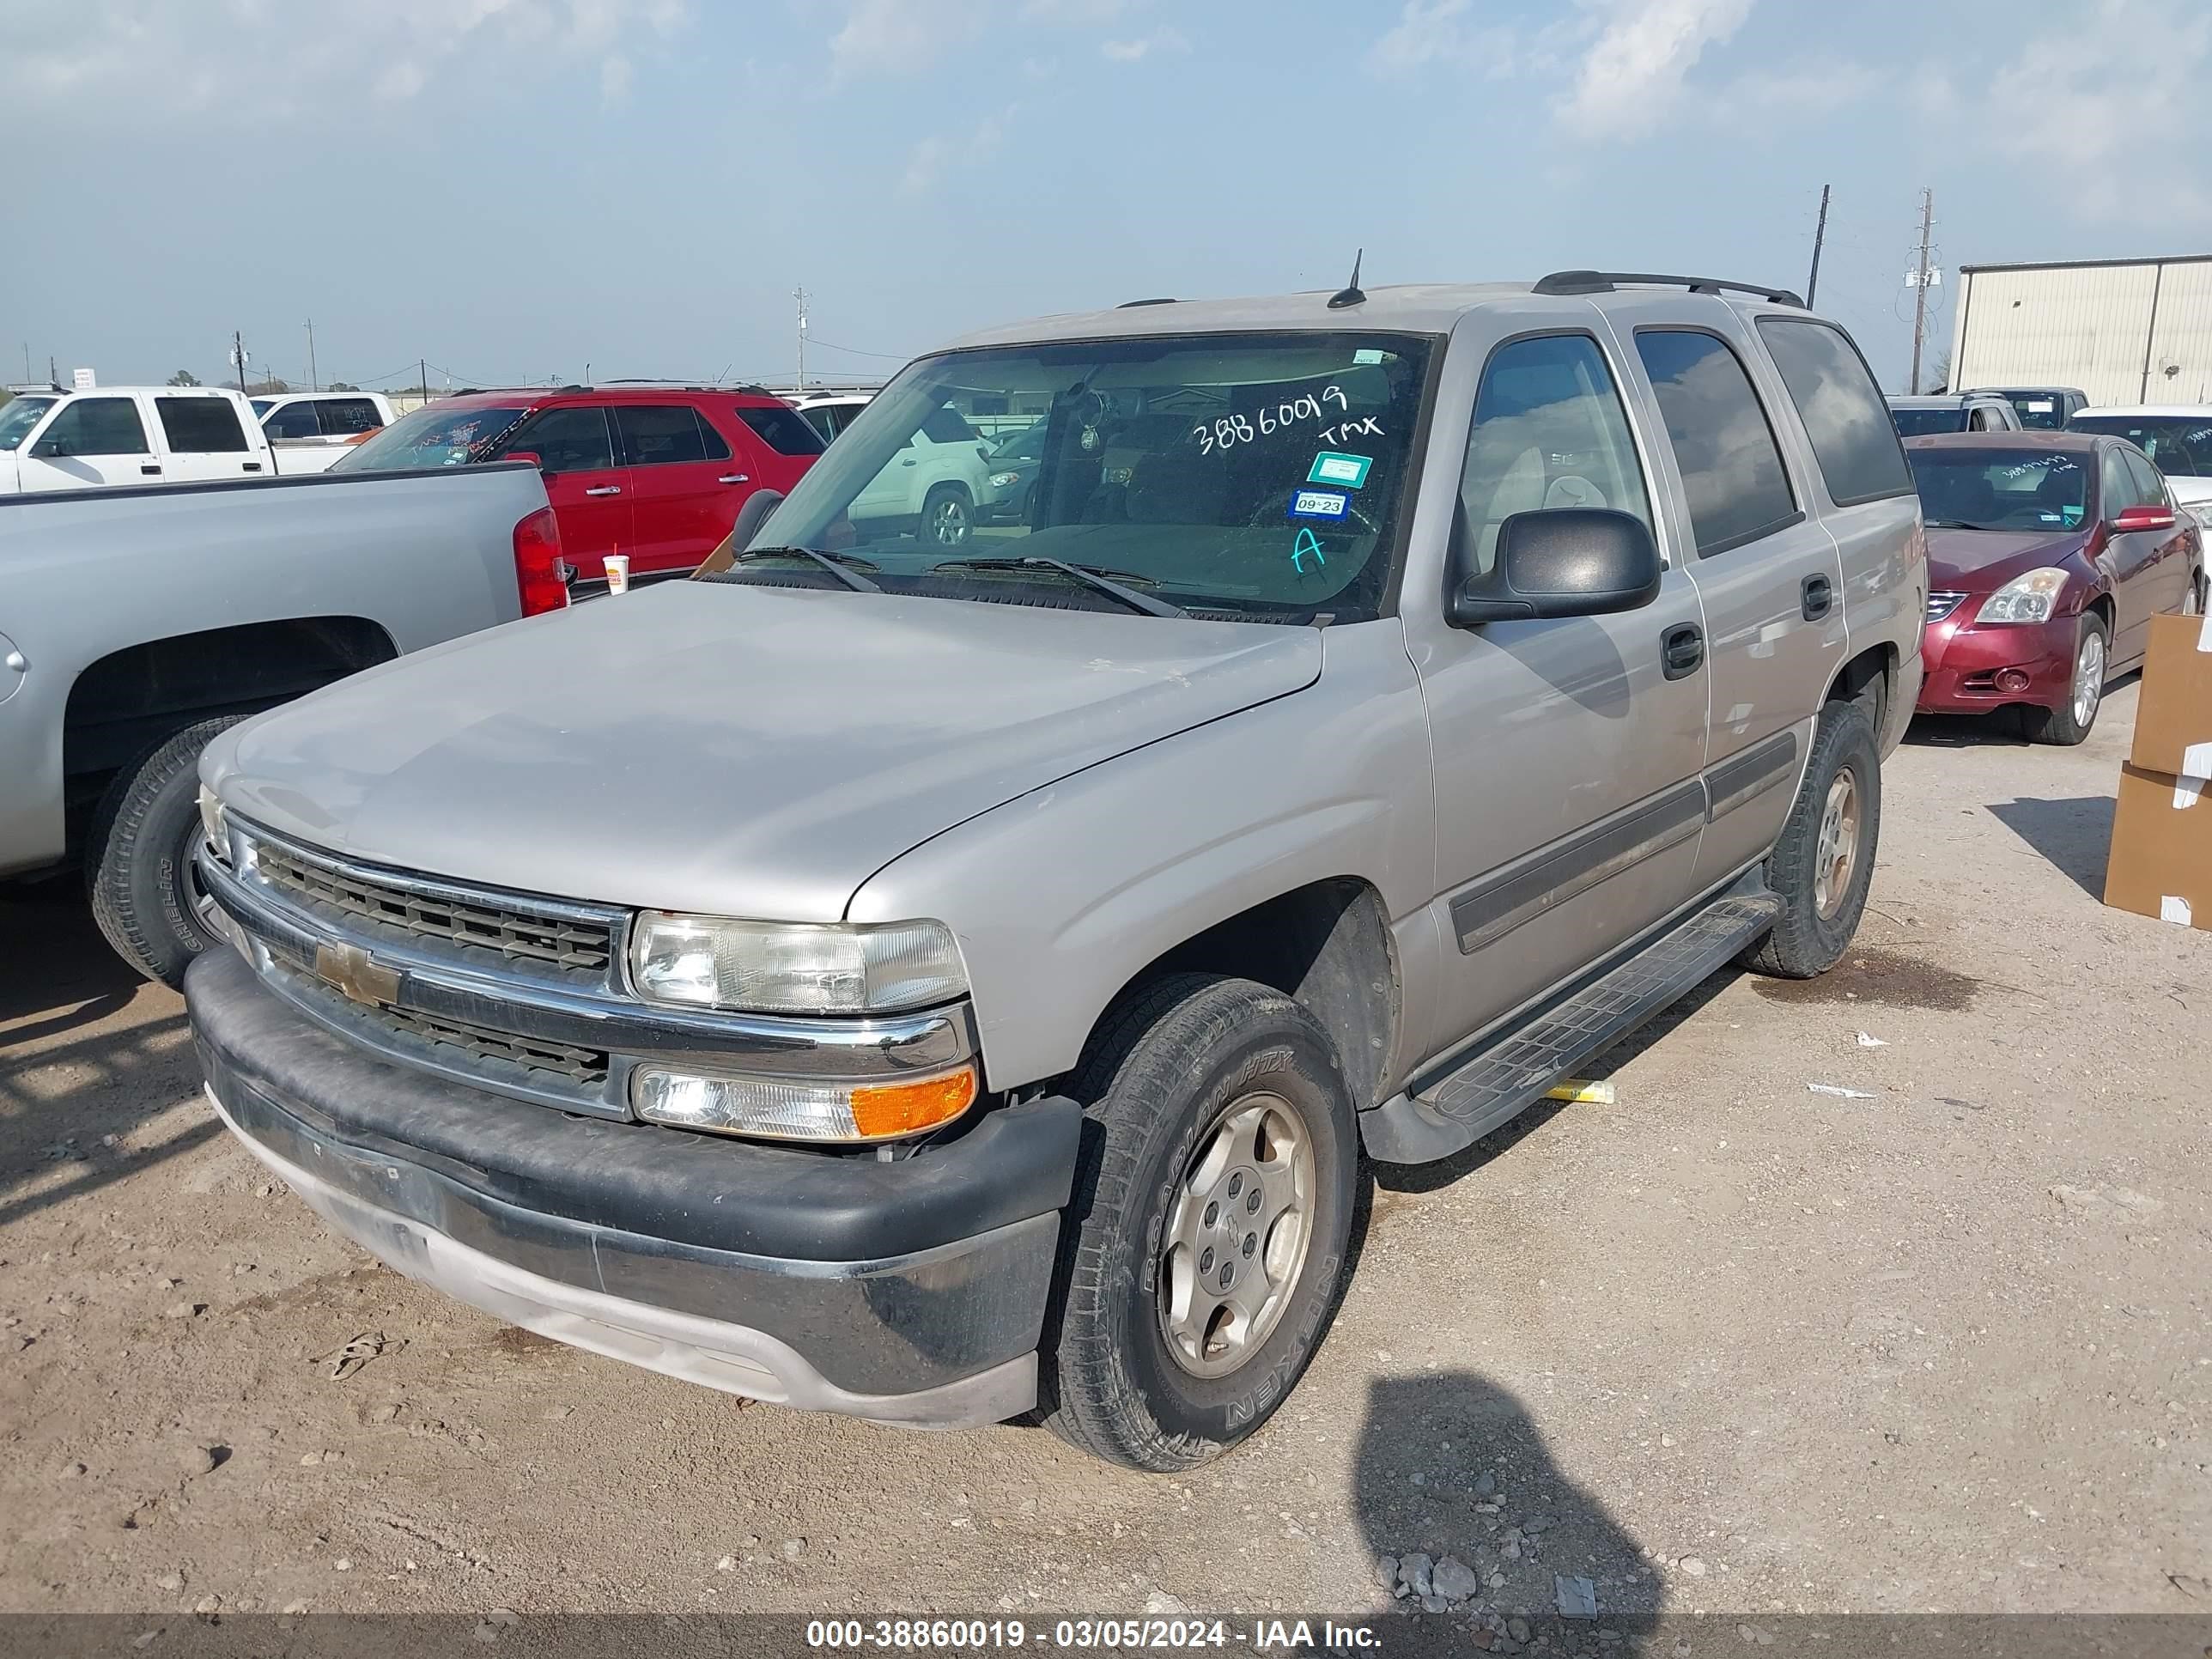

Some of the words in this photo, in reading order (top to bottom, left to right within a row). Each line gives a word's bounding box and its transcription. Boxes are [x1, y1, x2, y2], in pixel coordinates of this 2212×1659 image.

[1194, 386, 1346, 455] 38860019
[1319, 416, 1385, 446] TMX
[1291, 527, 1325, 573] A
[161, 858, 207, 953] CHELIN
[1144, 1076, 1231, 1291] ROADIAN
[1241, 1050, 1294, 1085] HTX
[1225, 1255, 1340, 1431] NEXEN
